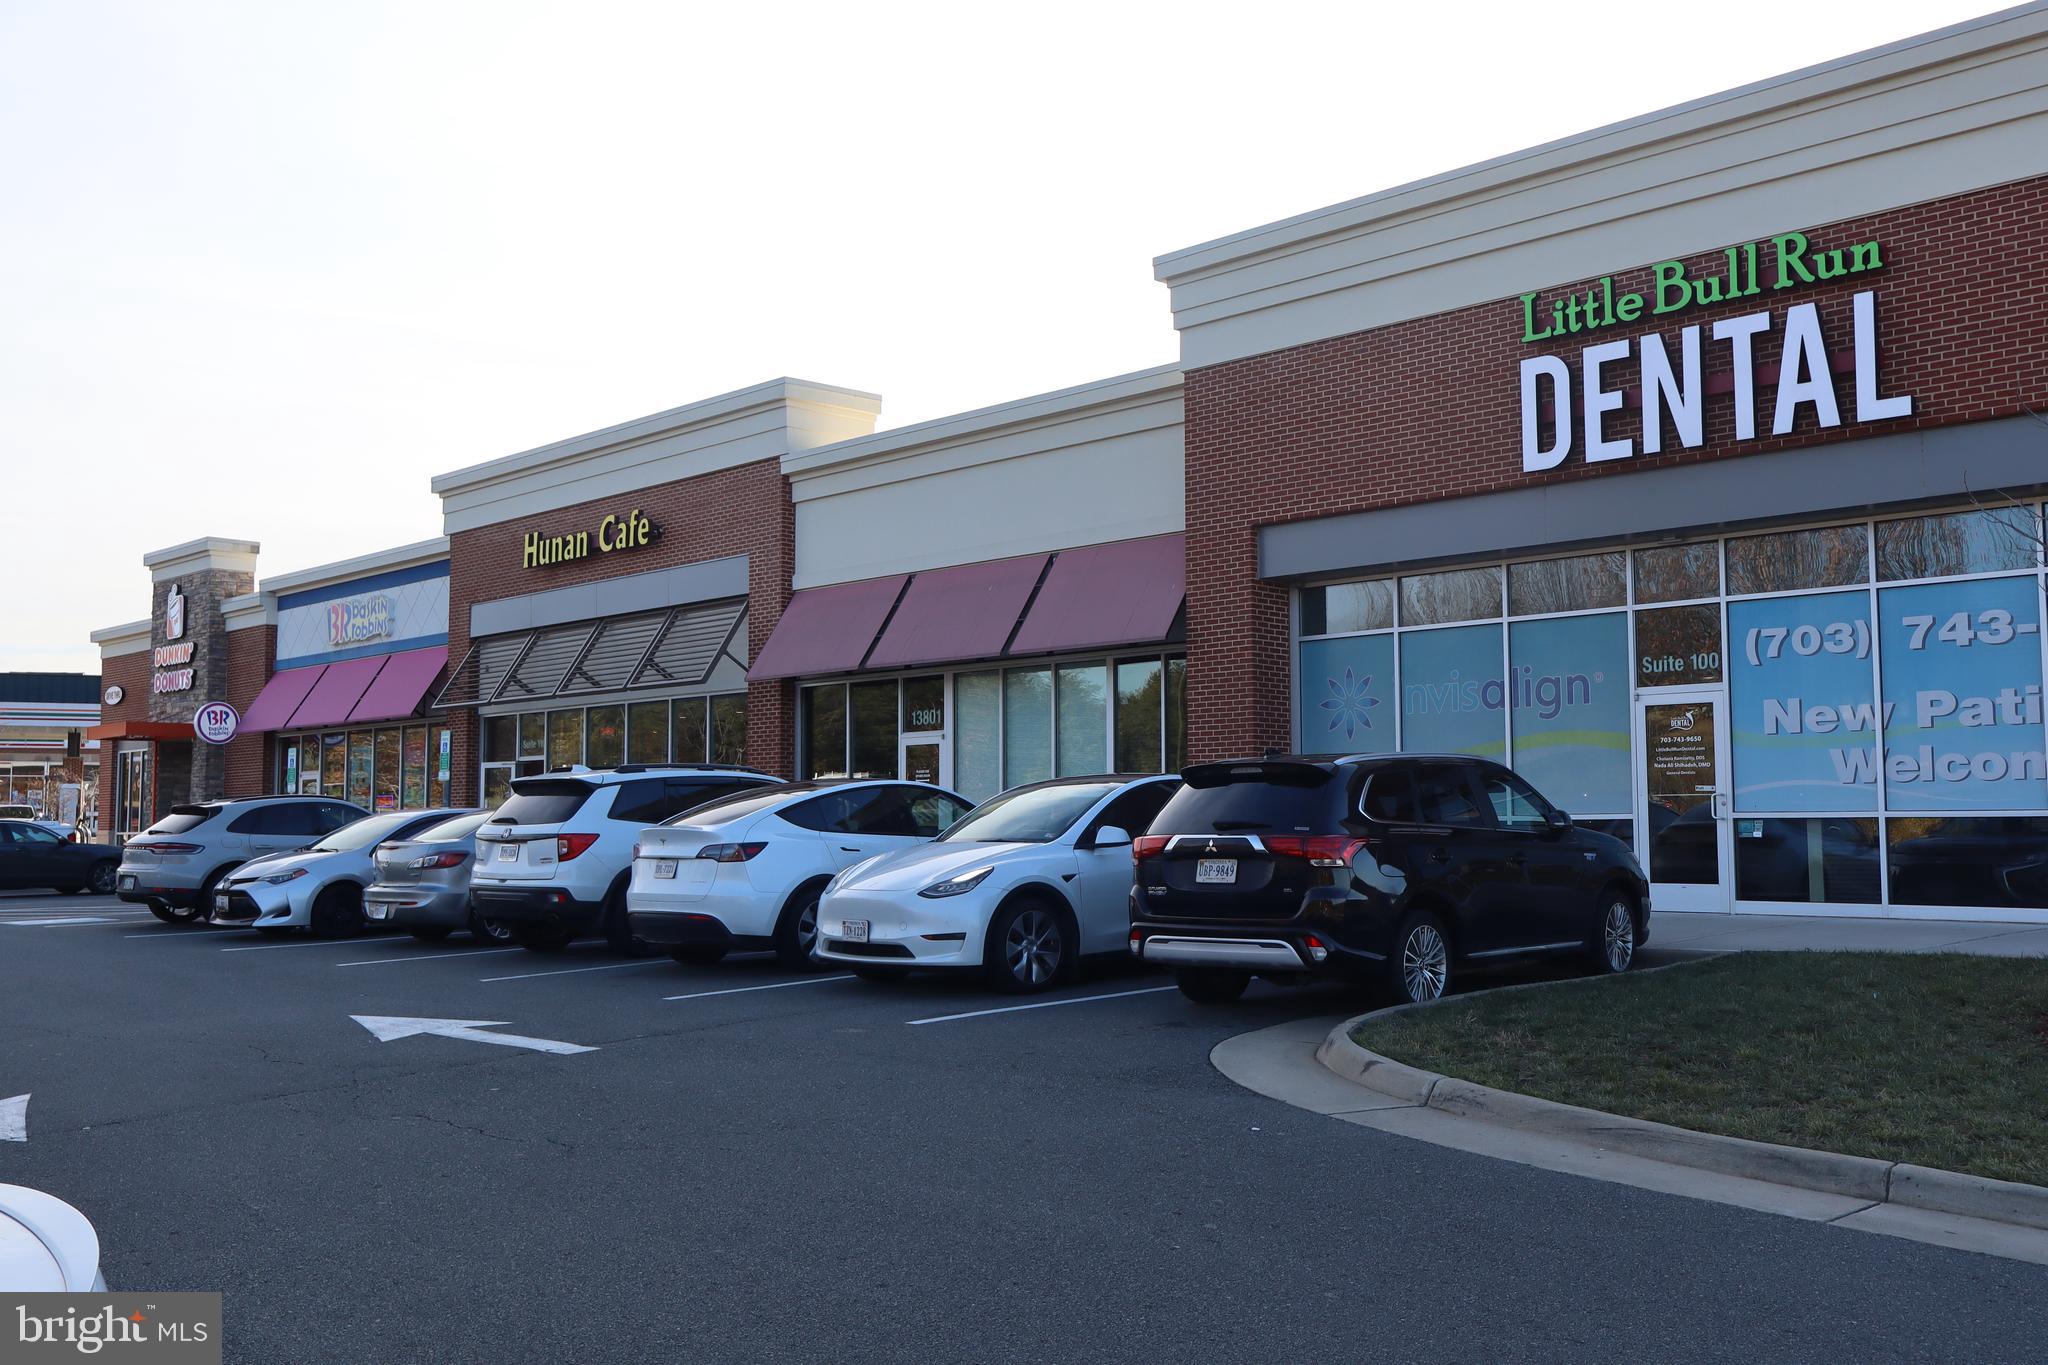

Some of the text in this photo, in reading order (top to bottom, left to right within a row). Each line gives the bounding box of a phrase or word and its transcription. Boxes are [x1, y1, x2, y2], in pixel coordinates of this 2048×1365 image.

[1520, 231, 1884, 343] Little Bull Run
[1520, 290, 1912, 473] DENTAL
[523, 509, 650, 569] Hunan Cafe
[352, 596, 388, 619] baskin
[327, 602, 352, 643] BR
[351, 617, 388, 639] robbins
[1745, 609, 2039, 666] (703) 743-
[155, 642, 194, 667] DUNKIN'
[1642, 652, 1719, 673] Suite 100
[154, 668, 194, 693] DONUTS
[1396, 664, 1592, 720] nvisalign
[206, 710, 230, 725] BR
[912, 708, 941, 726] 13801
[1763, 685, 2043, 735] New Pati
[1670, 719, 1690, 728] DENTAL
[1660, 735, 1702, 743] 703-743-9650
